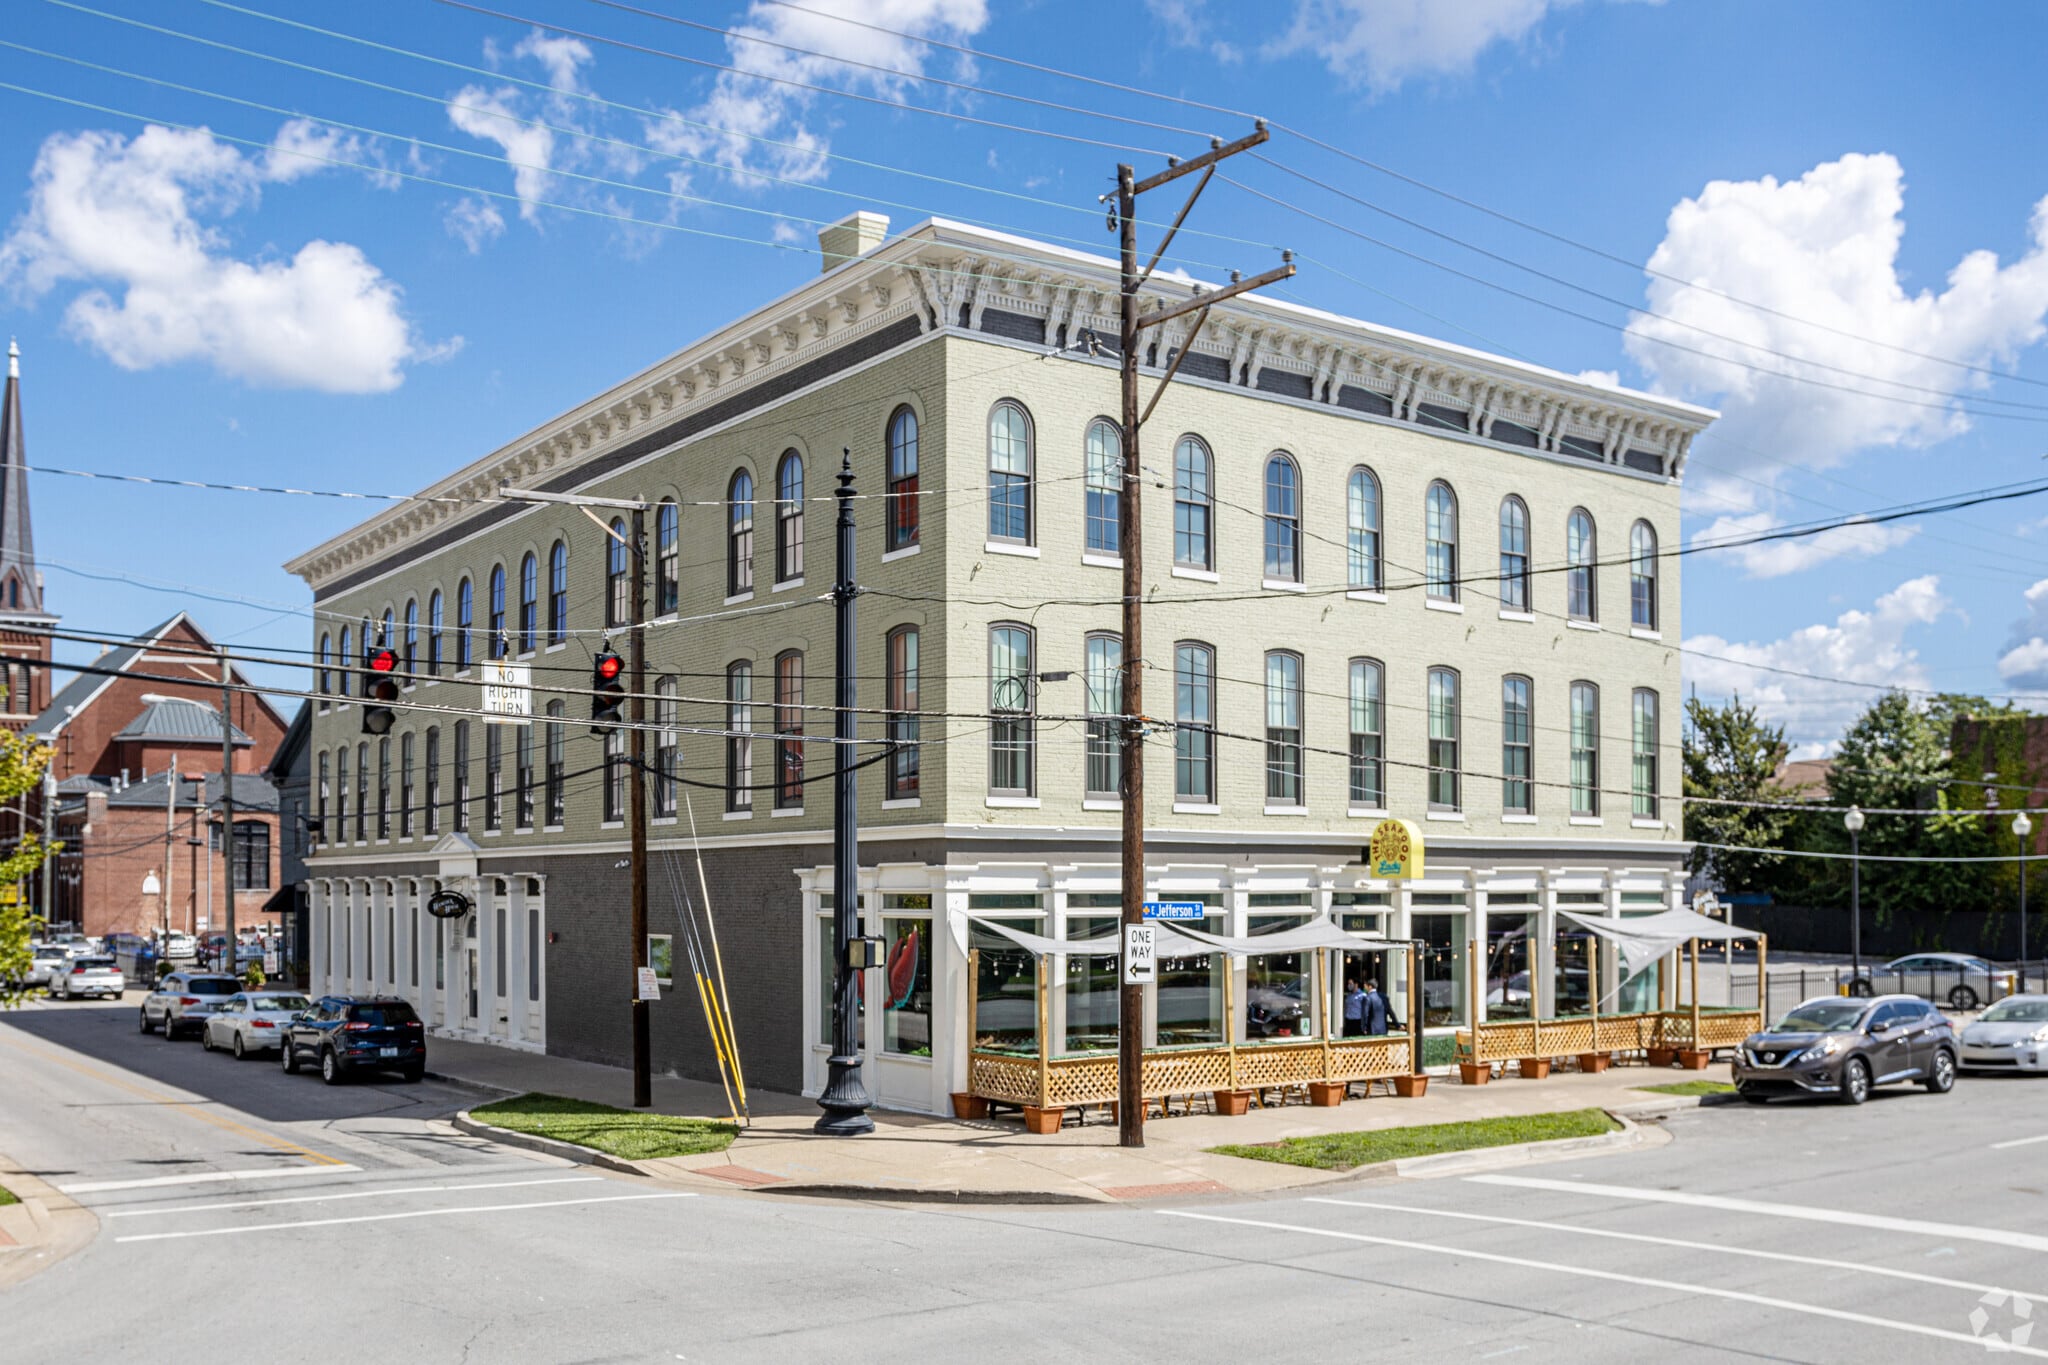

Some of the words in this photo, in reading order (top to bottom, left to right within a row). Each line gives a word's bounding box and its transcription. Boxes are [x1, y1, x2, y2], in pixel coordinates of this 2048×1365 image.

[498, 670, 514, 683] NO
[488, 684, 523, 699] RIGHT
[491, 701, 522, 715] TURN
[1372, 838, 1381, 861] THE
[1377, 823, 1409, 862] SEAFOOD
[1151, 905, 1156, 916] E
[1156, 903, 1194, 917] Jefferson
[1351, 919, 1366, 929] 601
[1131, 930, 1151, 943] ONE
[1130, 946, 1151, 958] WAY
